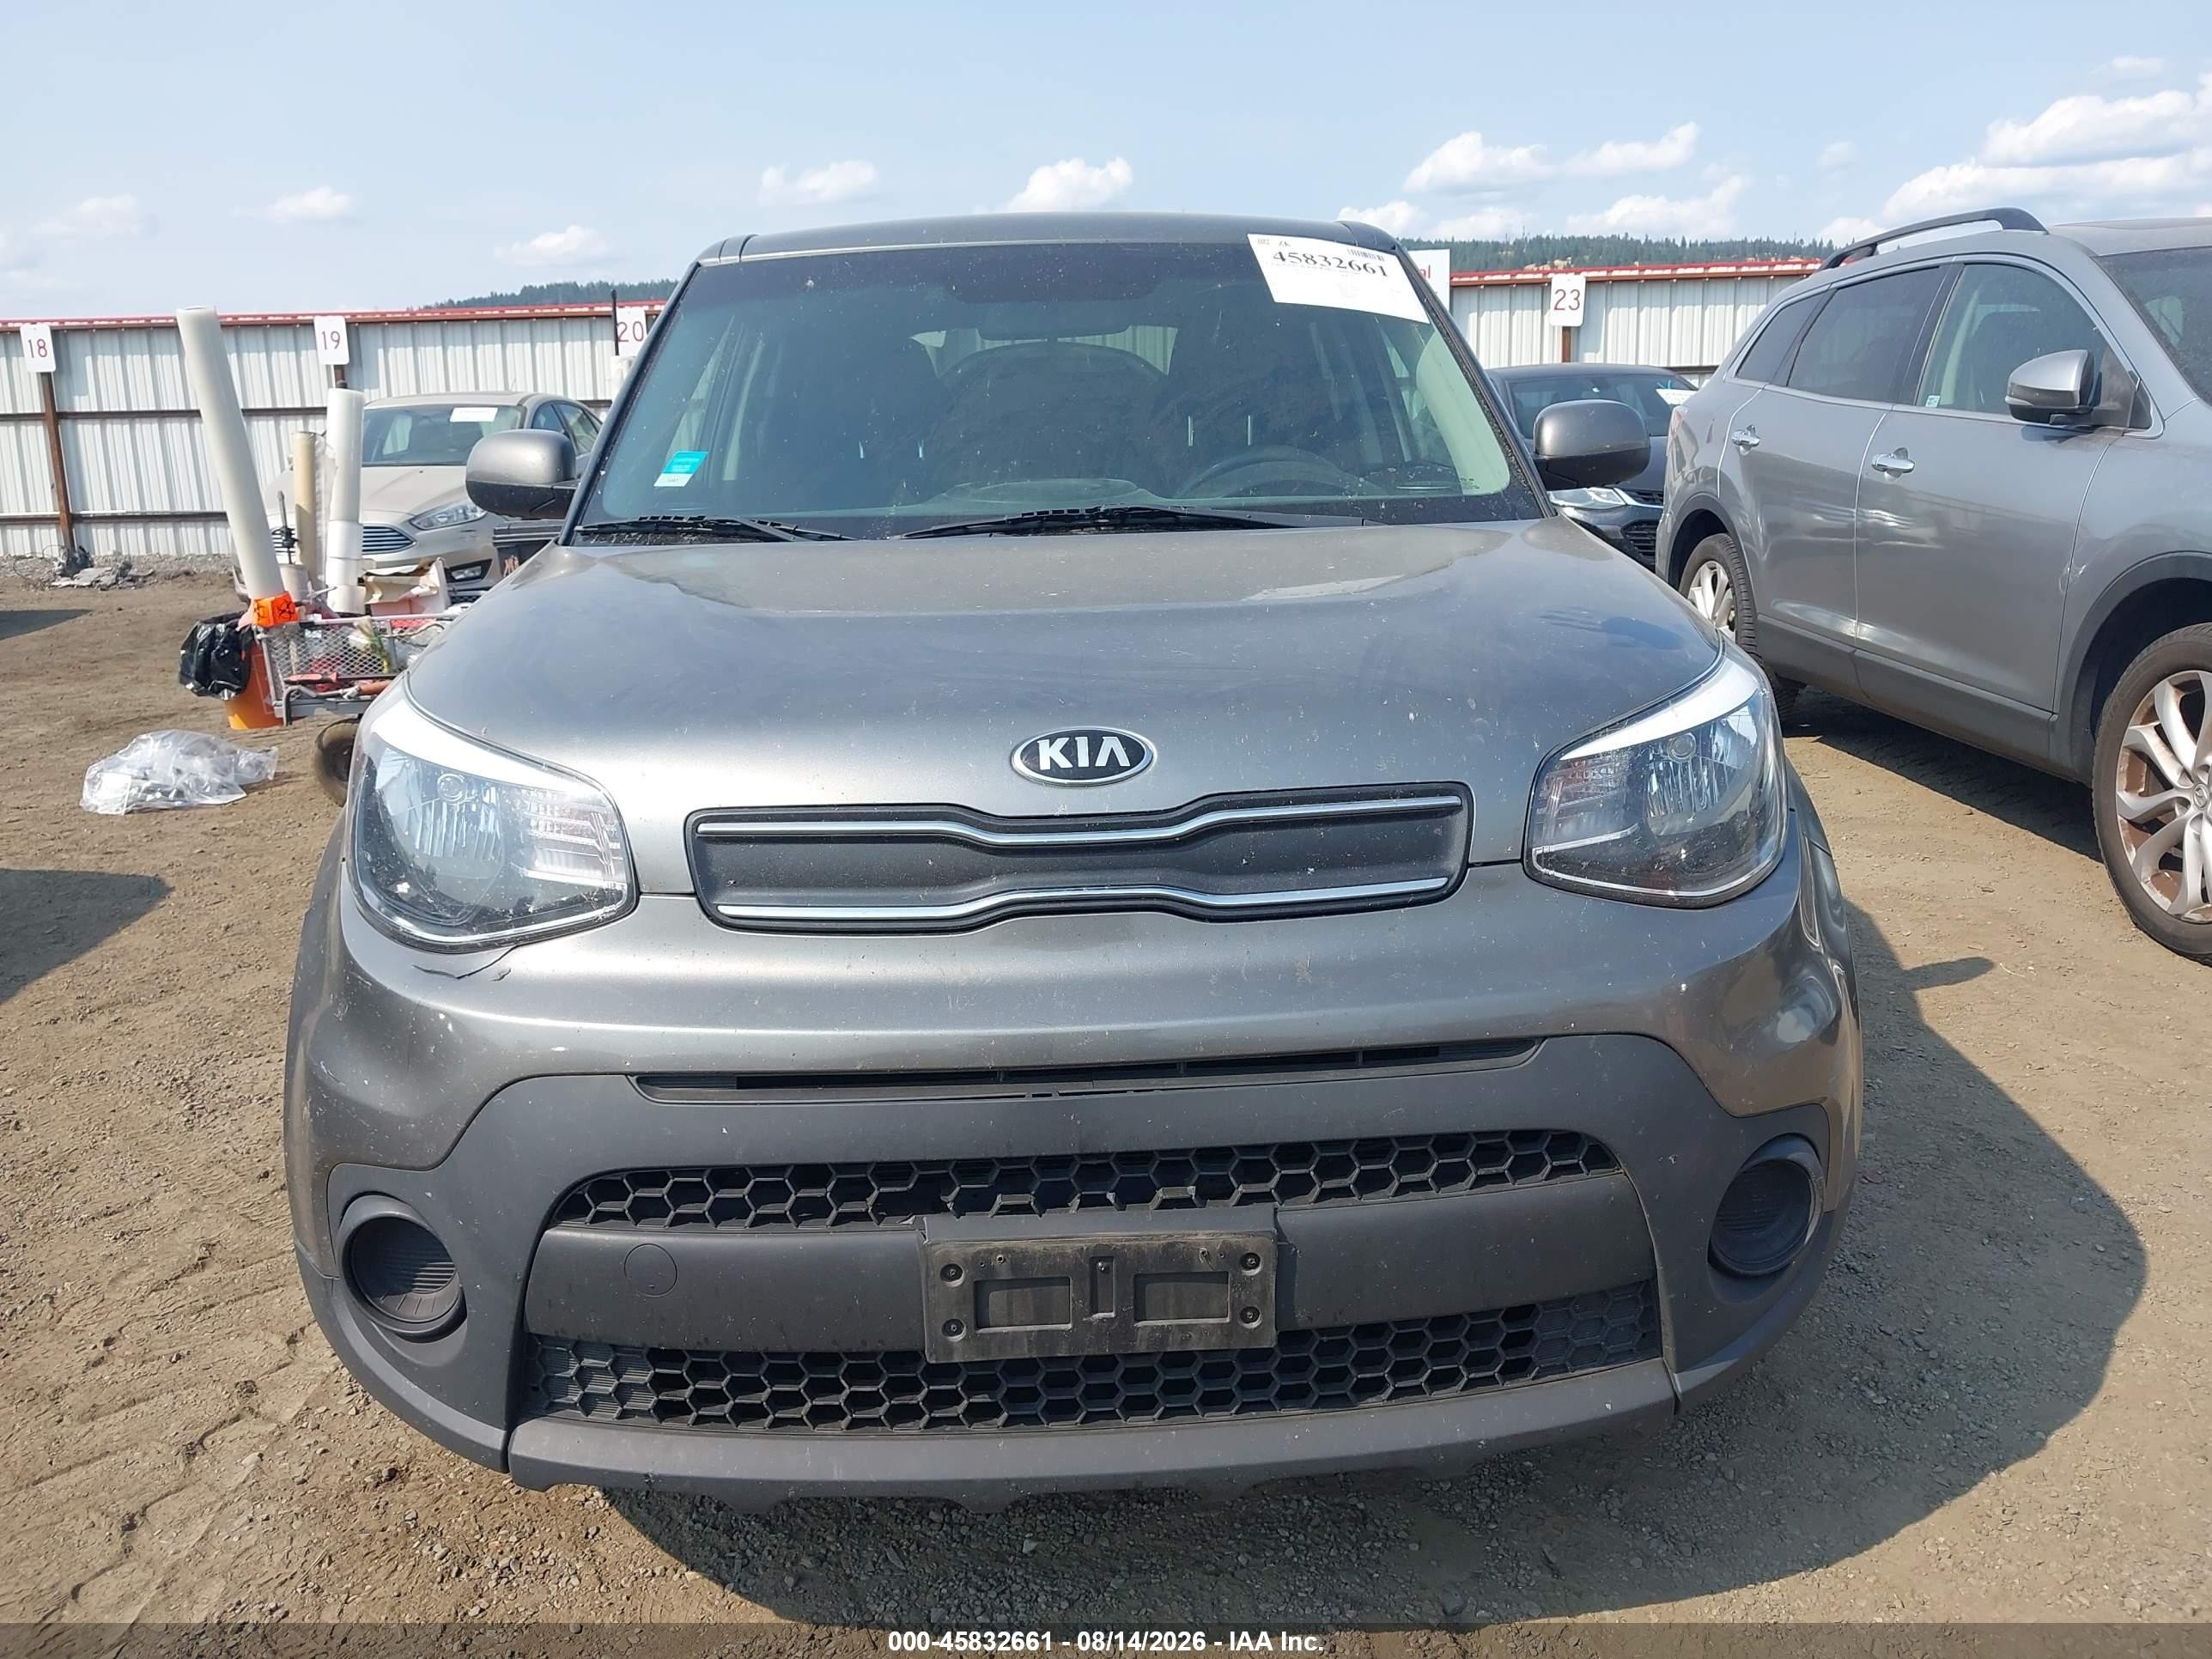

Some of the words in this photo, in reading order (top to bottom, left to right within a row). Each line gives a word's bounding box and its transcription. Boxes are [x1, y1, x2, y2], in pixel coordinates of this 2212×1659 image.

[1273, 252, 1389, 277] 45832661
[1553, 289, 1581, 311] 23
[321, 331, 341, 350] 19
[617, 320, 645, 342] 20
[27, 338, 48, 358] 18
[1036, 736, 1131, 770] KIA
